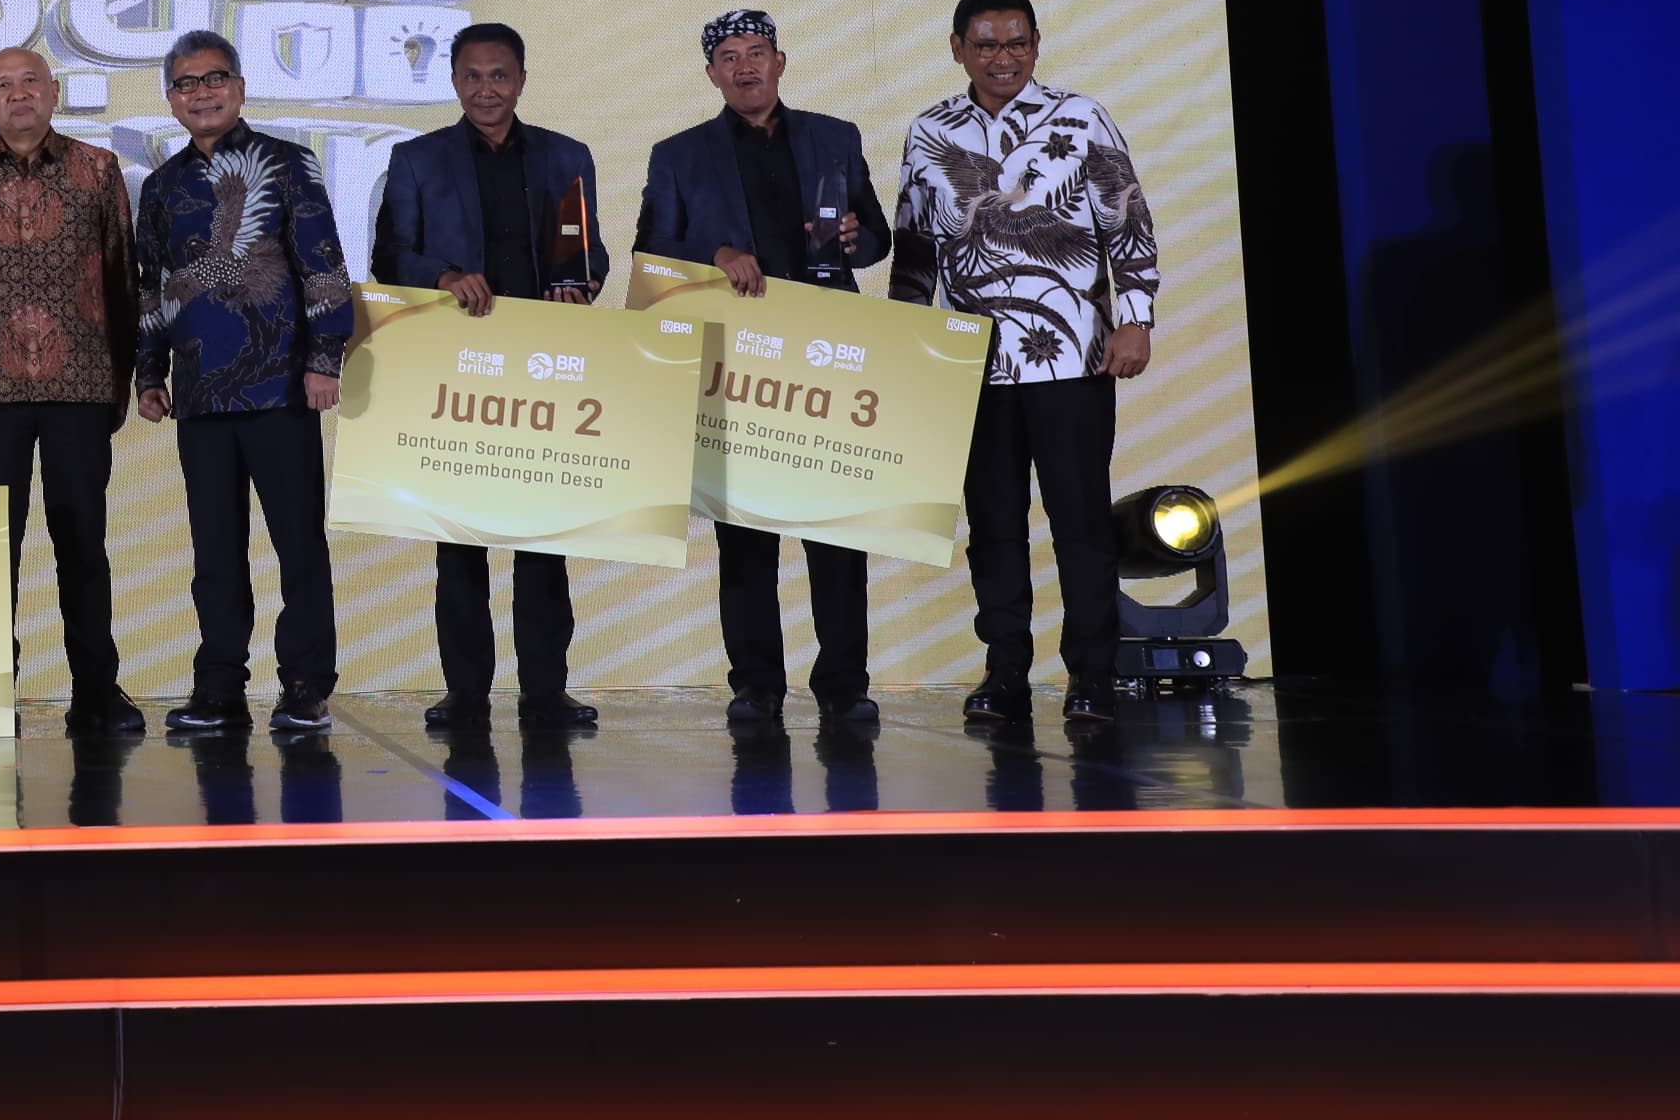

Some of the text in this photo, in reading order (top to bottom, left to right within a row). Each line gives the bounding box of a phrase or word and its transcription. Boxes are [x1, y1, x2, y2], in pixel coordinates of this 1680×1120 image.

[673, 321, 693, 335] BRI
[737, 327, 771, 346] desa
[959, 319, 981, 336] BRI
[458, 348, 493, 364] desa
[735, 339, 782, 361] brilian
[835, 343, 866, 363] BRI
[457, 361, 504, 377] brilian
[555, 354, 585, 373] BRI
[833, 361, 863, 373] peduli
[555, 372, 584, 382] peduli
[704, 360, 880, 428] Juara 3
[431, 383, 603, 437] Juara 2
[397, 432, 631, 471] Bantuan Sarana Prasarana
[746, 421, 807, 447] Sarana
[814, 435, 904, 466] Prasarana
[420, 456, 604, 489] Pengembangan Desa
[831, 459, 875, 481] Desa
